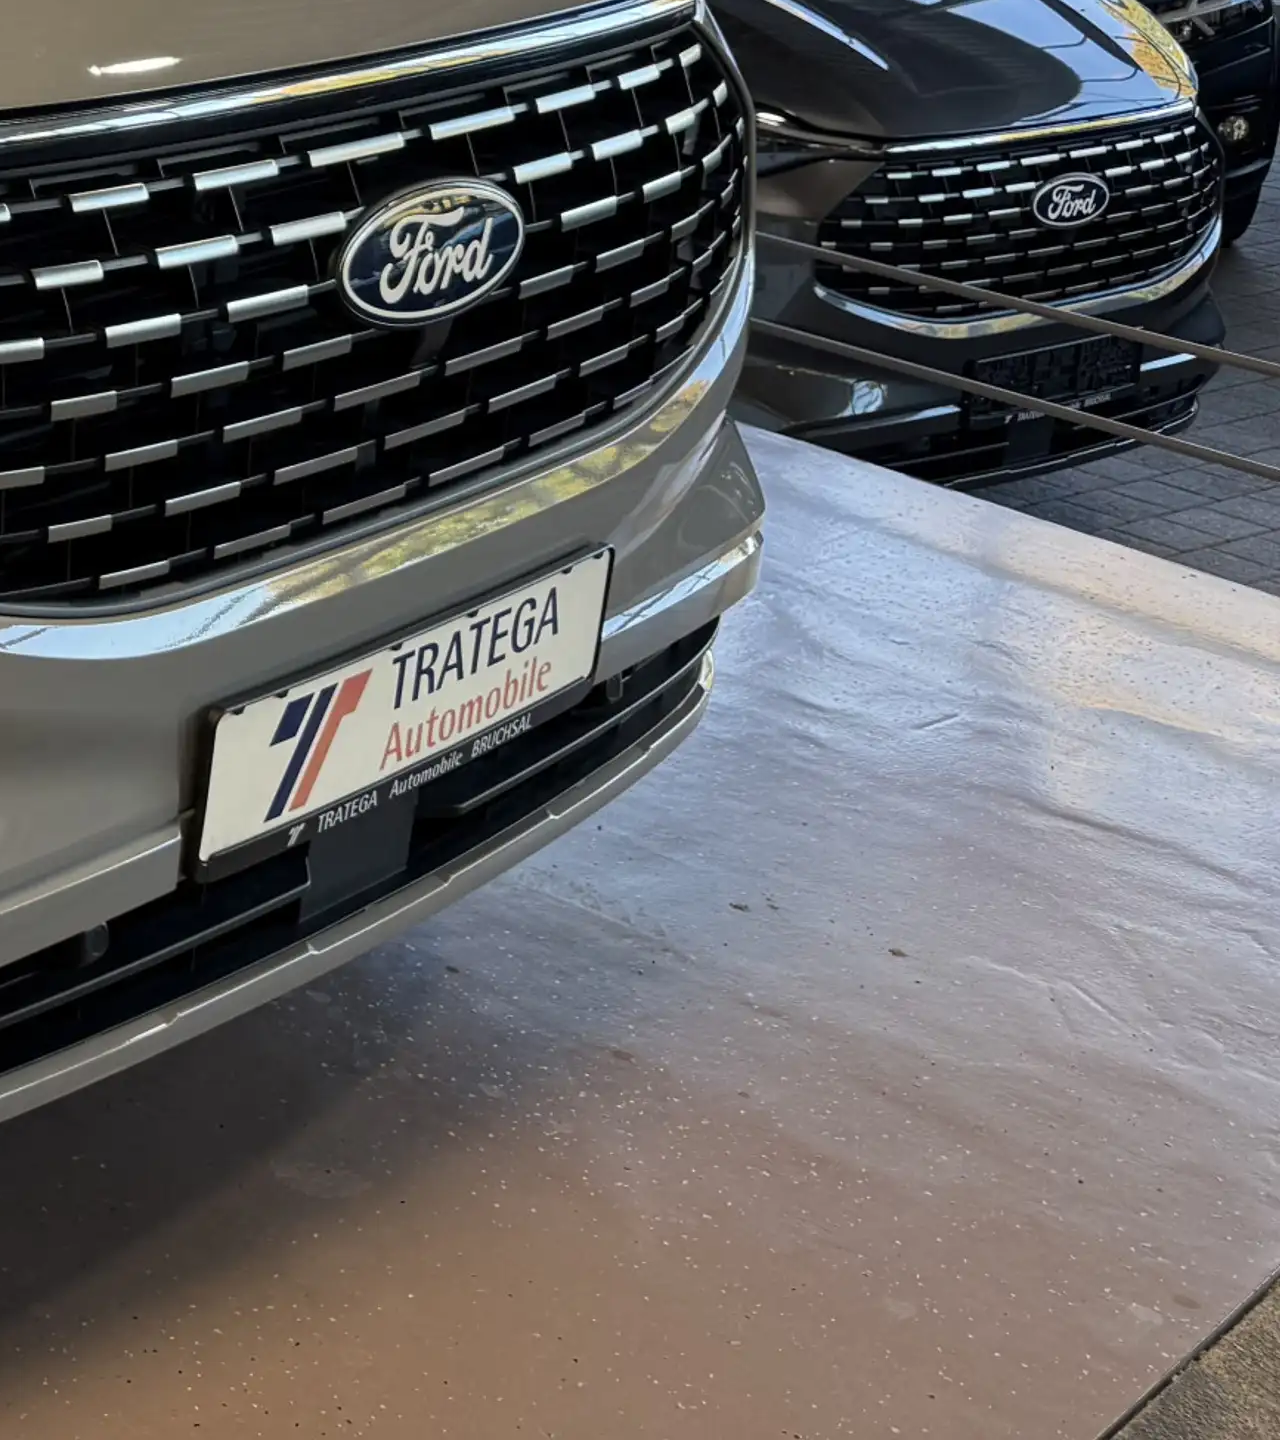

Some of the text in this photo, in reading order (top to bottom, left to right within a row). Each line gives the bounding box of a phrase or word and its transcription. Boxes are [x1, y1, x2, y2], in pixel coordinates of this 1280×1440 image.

[379, 206, 495, 304] Ford
[1046, 183, 1097, 218] Ford
[391, 586, 560, 710] TRATEGA
[378, 656, 553, 772] Automobile
[317, 713, 533, 834] TRATEGA Automobile BRUCHSAL
